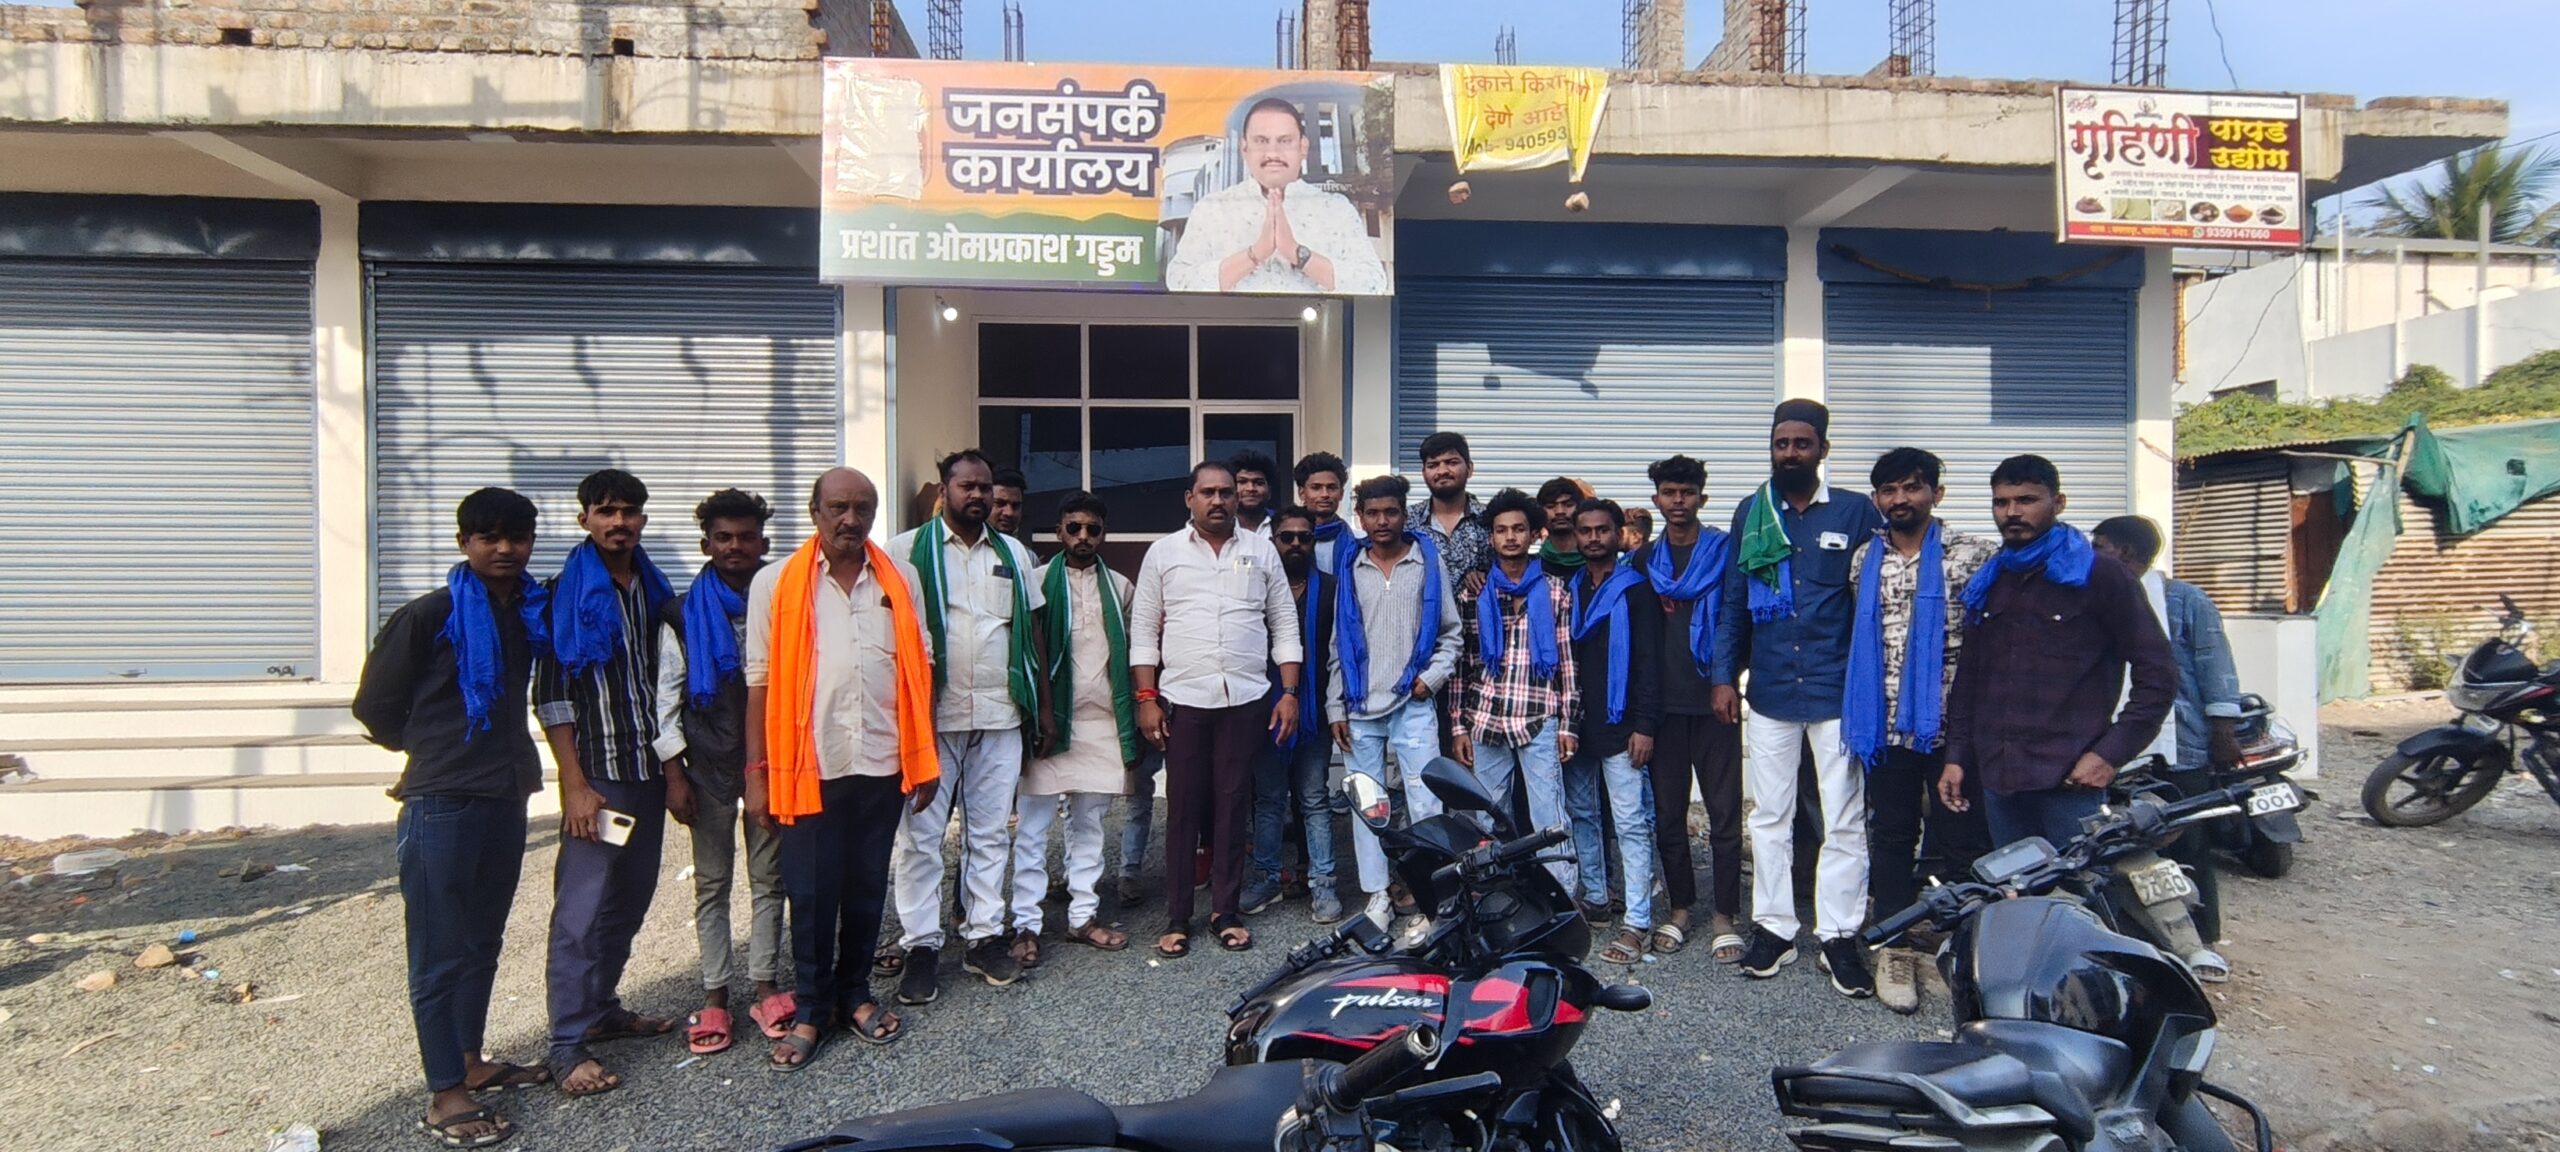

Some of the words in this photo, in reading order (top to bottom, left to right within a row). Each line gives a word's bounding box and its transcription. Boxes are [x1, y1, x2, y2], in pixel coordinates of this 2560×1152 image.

[1464, 70, 1515, 98] दुकाने
[946, 81, 1161, 139] जनसंपर्क
[1484, 104, 1514, 130] देणे
[1523, 101, 1568, 125] आहे
[2069, 110, 2199, 179] गृहिणी
[2208, 119, 2288, 143] पापड
[946, 138, 1156, 194] कार्यालय
[2208, 141, 2290, 170] उद्योग
[840, 223, 919, 260] प्रशांत
[926, 223, 1072, 263] ओमप्रकाश
[1325, 987, 1443, 1020] pulsar
